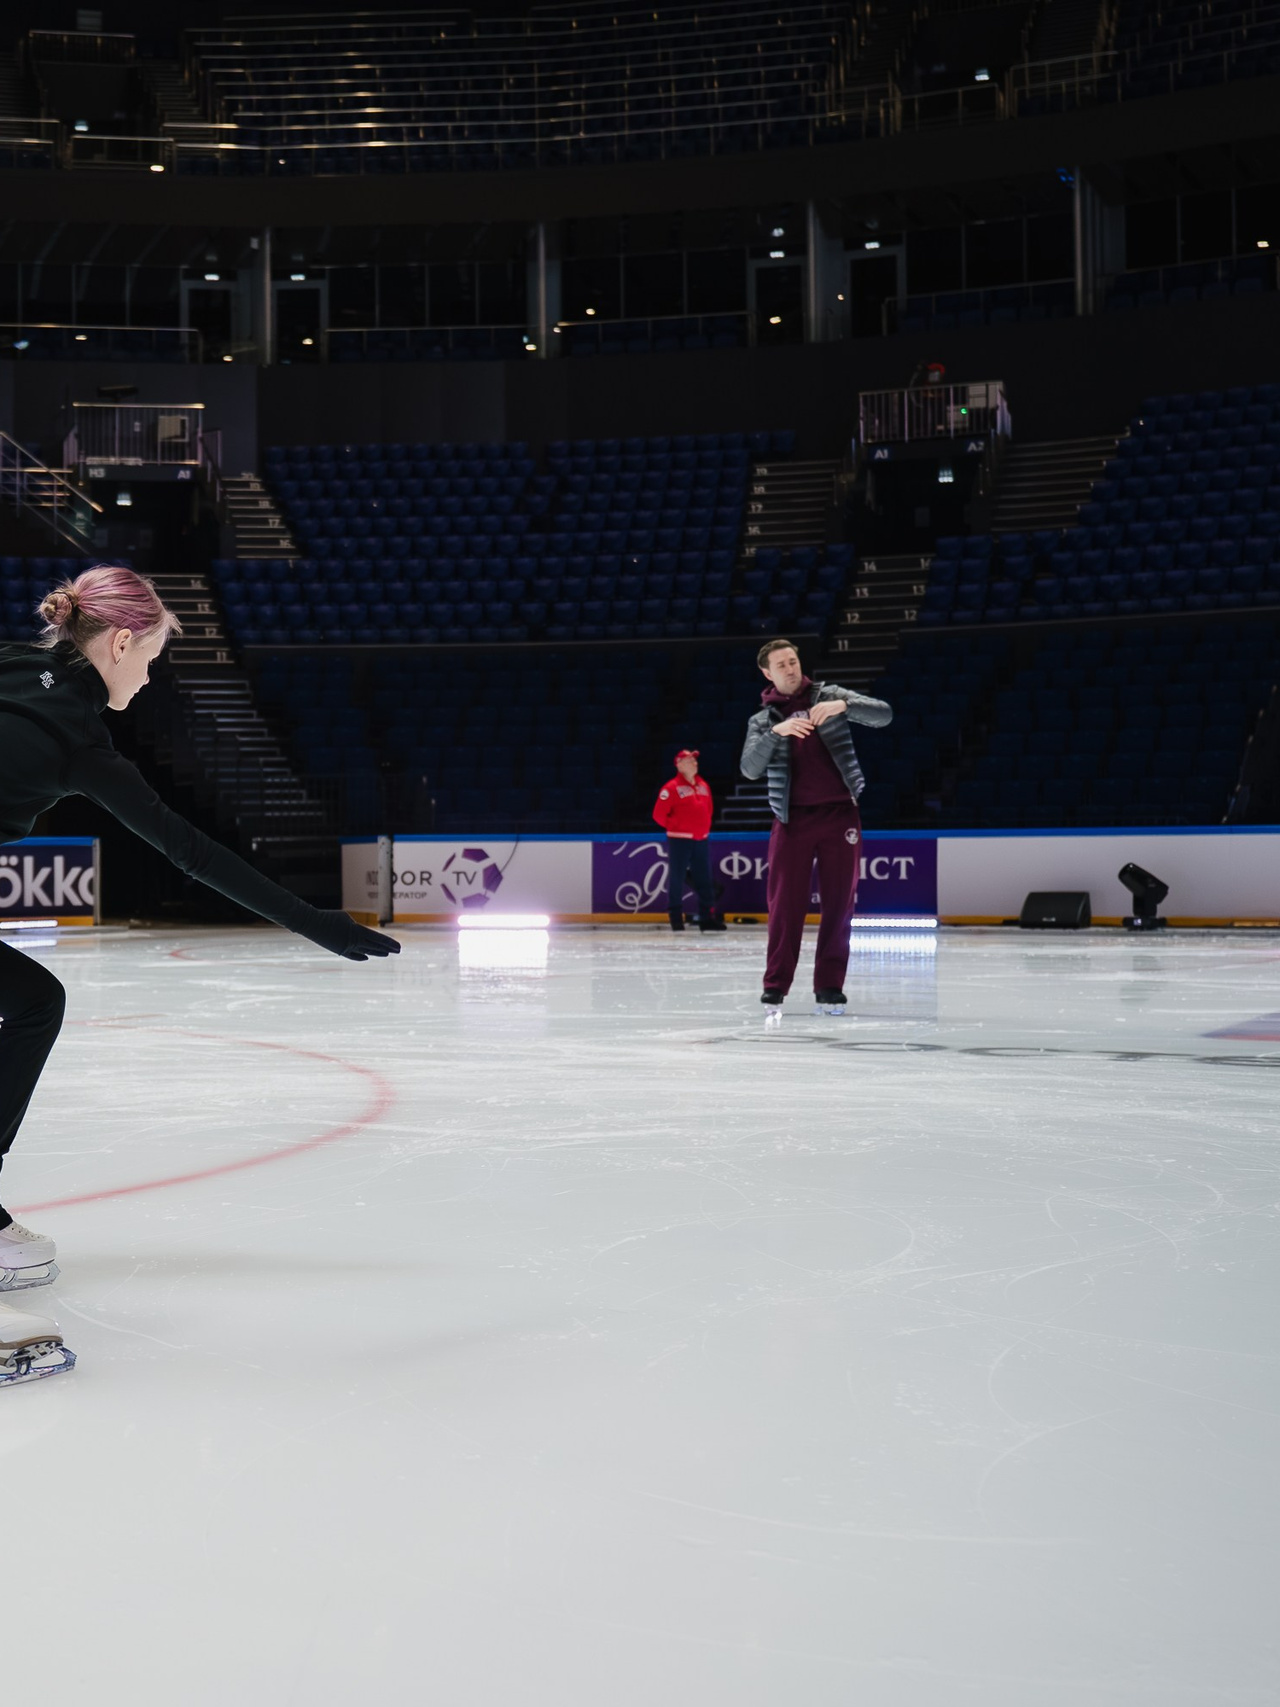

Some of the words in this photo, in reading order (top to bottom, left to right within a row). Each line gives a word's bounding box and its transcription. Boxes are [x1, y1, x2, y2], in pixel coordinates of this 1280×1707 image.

[846, 613, 860, 624] 12
[904, 609, 917, 621] 12
[838, 639, 849, 651] 11
[453, 871, 477, 886] TV
